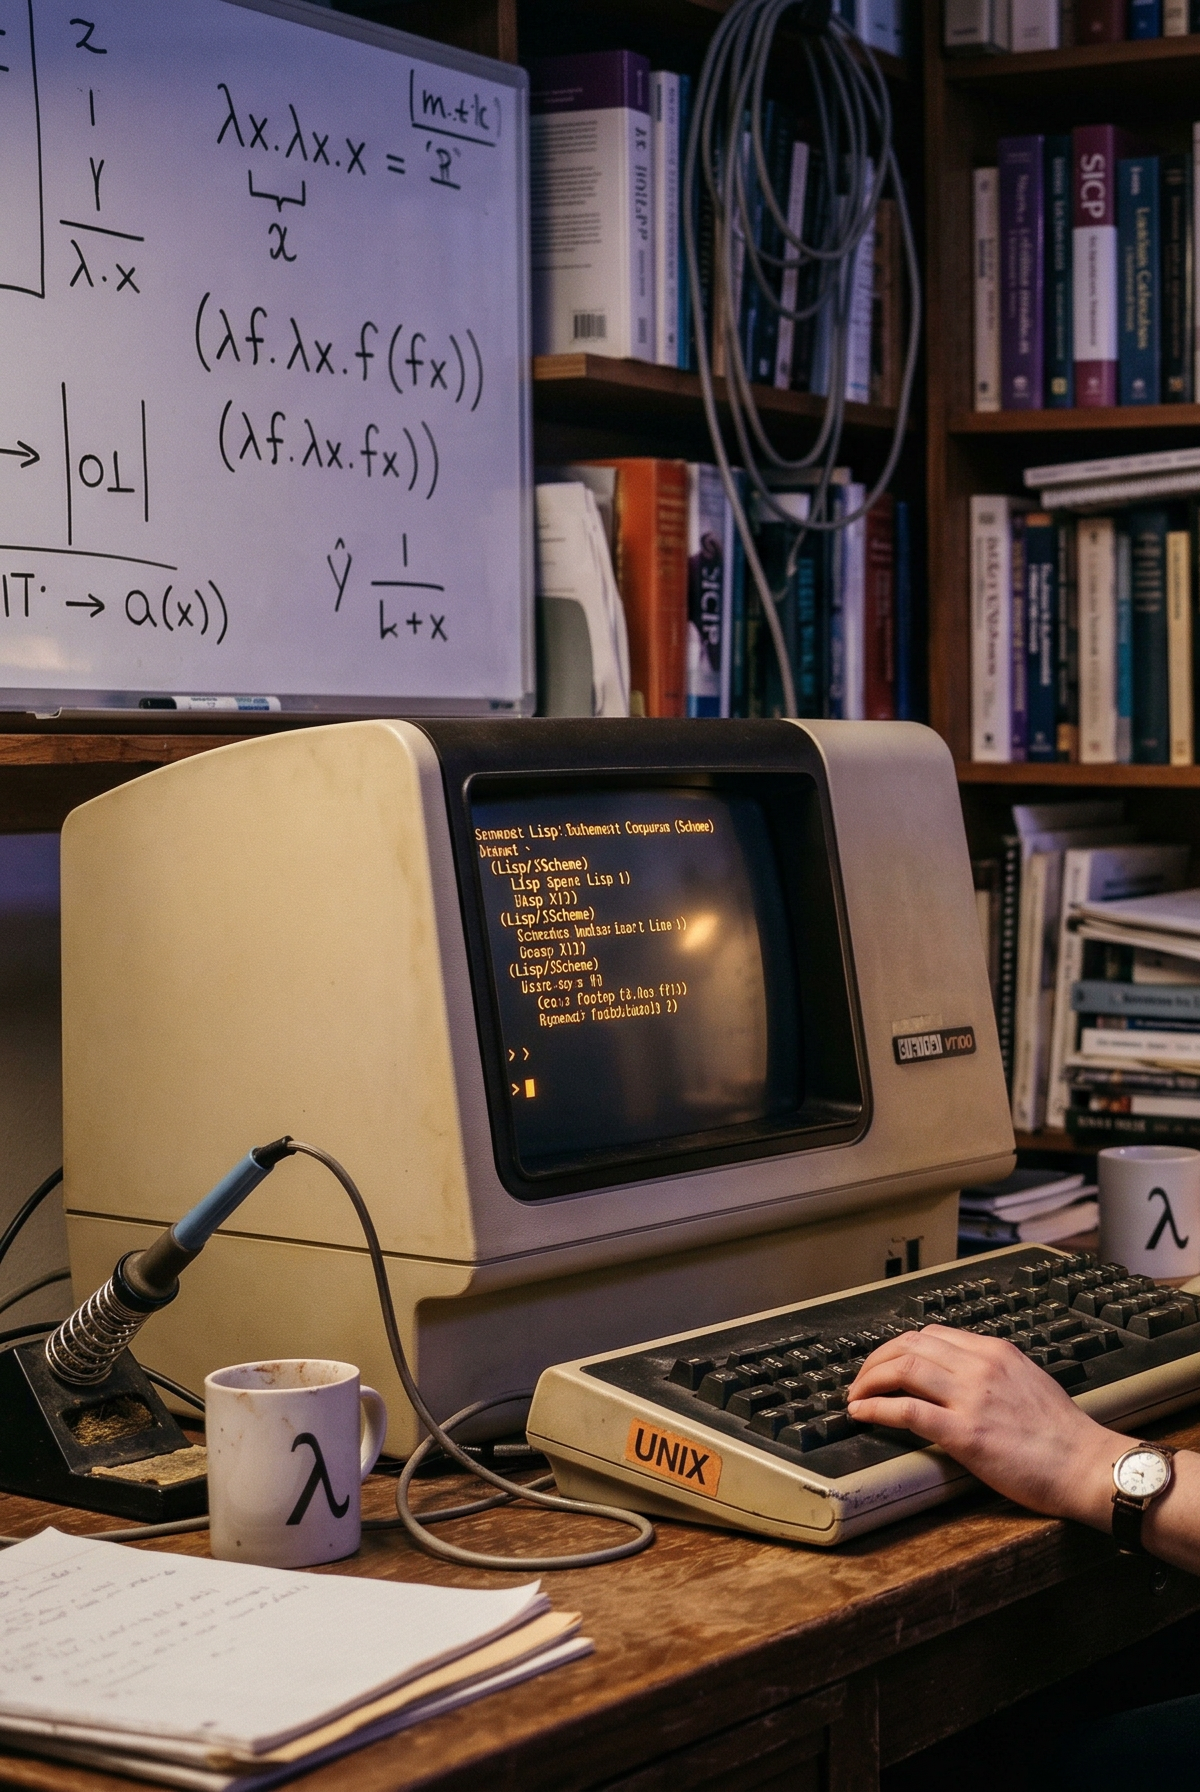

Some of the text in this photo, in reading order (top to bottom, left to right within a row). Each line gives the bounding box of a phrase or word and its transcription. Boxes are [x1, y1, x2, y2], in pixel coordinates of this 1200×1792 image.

[1081, 153, 1106, 218] SICP
[586, 872, 615, 888] Lisp
[1146, 1186, 1189, 1250] λ
[285, 1432, 350, 1526] λ
[634, 1427, 710, 1486] UNIX
